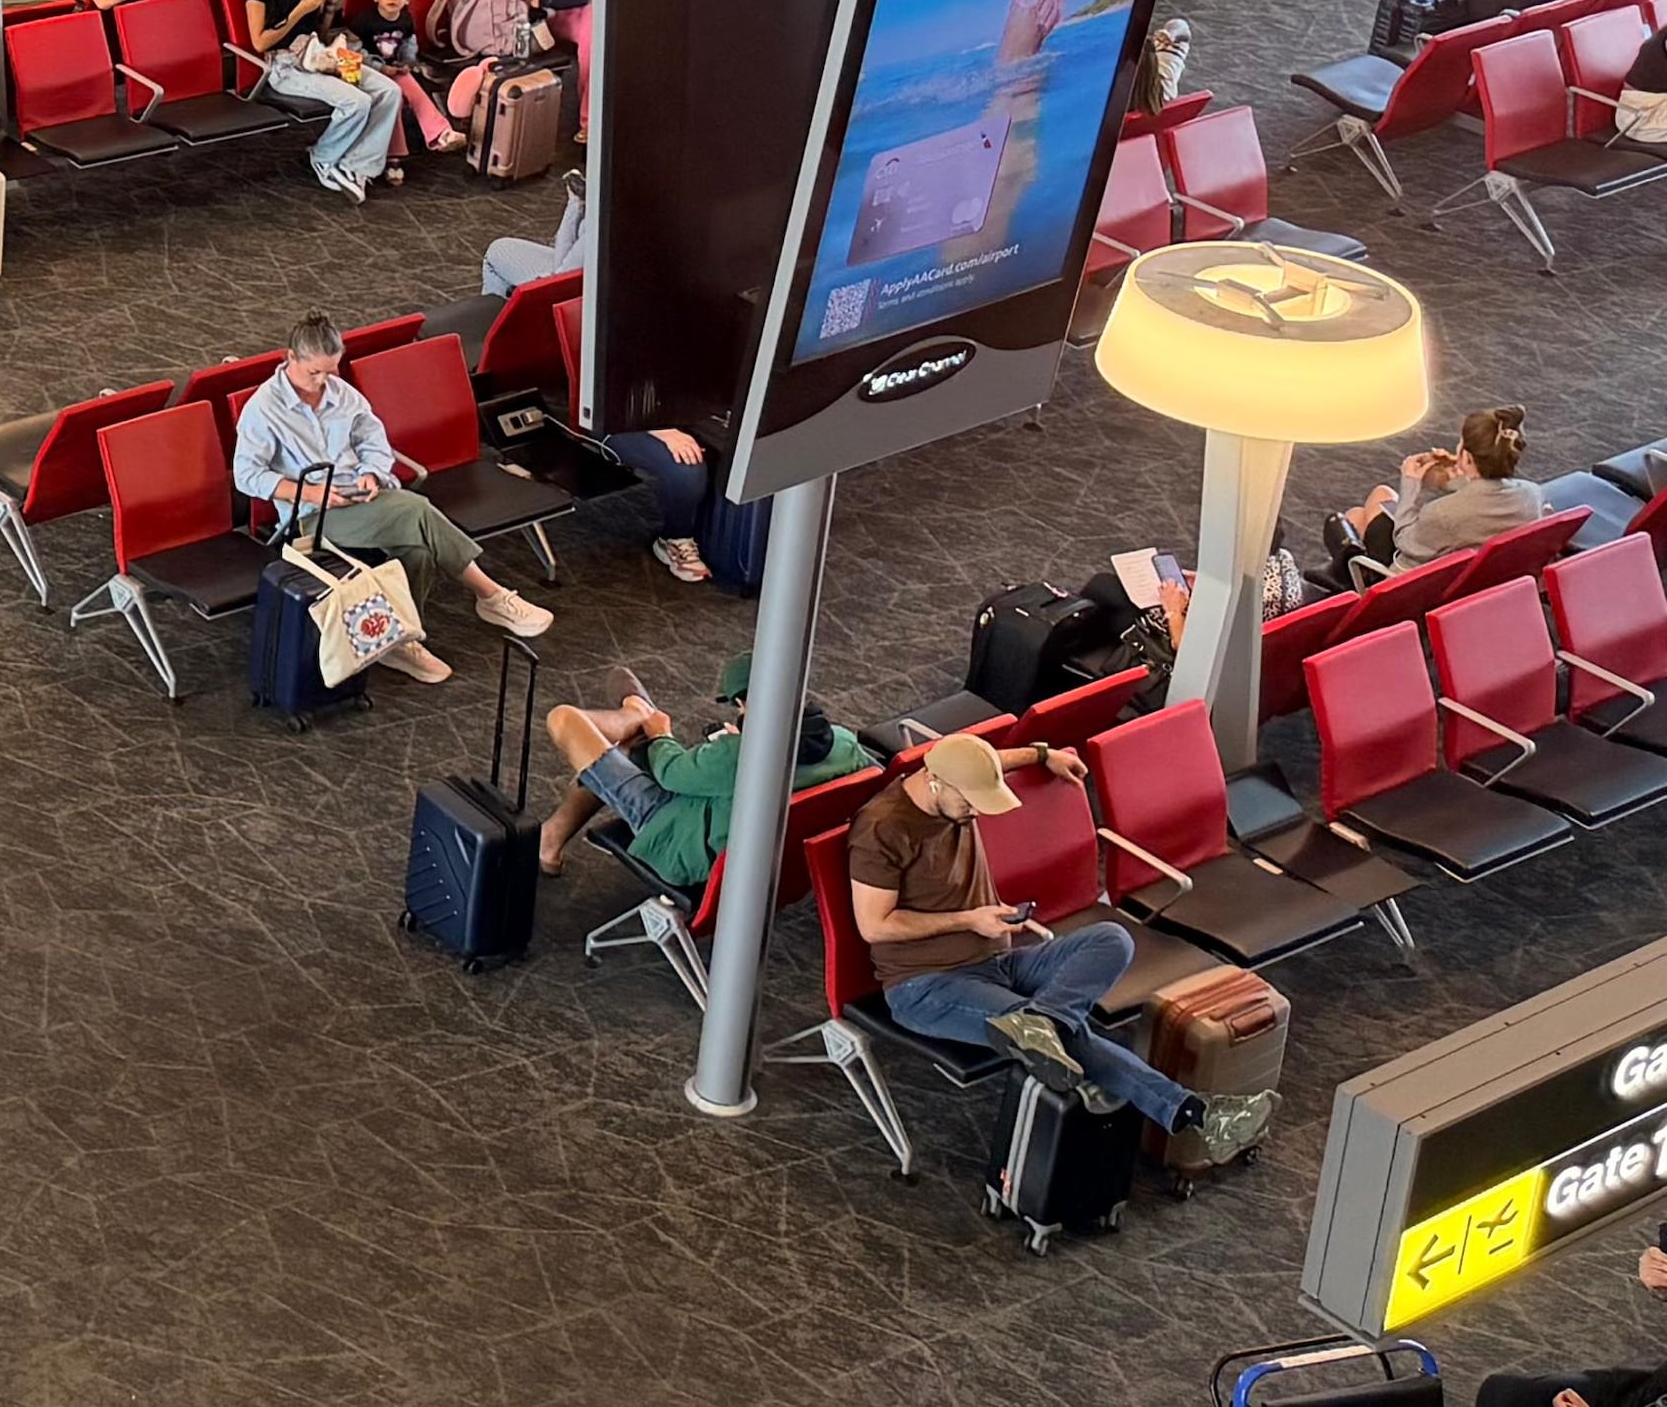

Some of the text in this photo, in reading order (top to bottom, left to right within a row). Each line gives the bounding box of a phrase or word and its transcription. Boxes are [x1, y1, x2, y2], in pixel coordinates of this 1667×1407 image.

[880, 243, 1020, 297] ApplyAACard.com/airport
[1613, 1044, 1667, 1100] Ga
[1546, 1142, 1651, 1219] Gate
